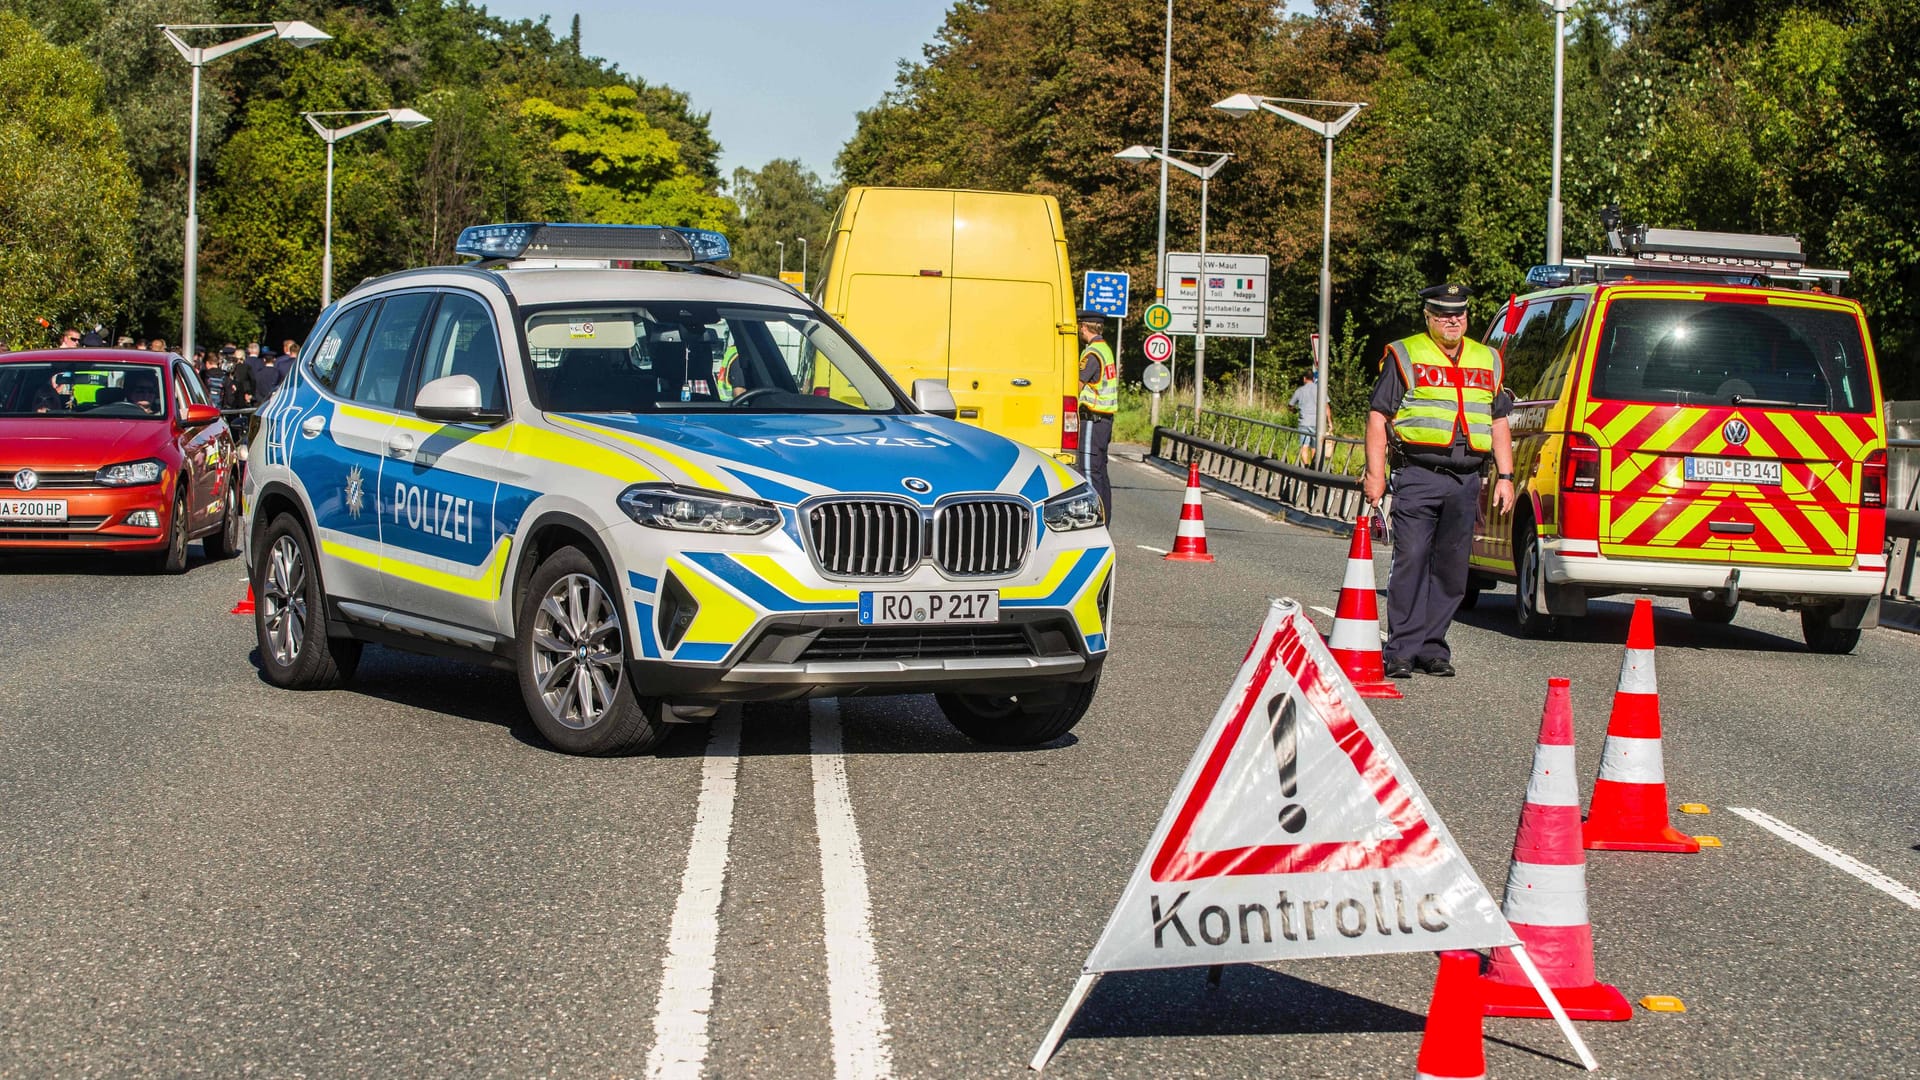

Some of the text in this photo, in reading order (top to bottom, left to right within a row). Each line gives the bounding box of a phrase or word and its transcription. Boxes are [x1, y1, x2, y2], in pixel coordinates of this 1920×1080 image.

[1182, 304, 1251, 313] wwwauttabelle.de
[1153, 310, 1164, 325] H
[1151, 342, 1166, 354] 70
[1414, 363, 1494, 391] POLIZEI
[740, 436, 952, 448] POLIZEI
[1696, 460, 1723, 476] BGD
[1734, 462, 1751, 477] FB
[1754, 463, 1779, 479] 141
[0, 502, 62, 516] A 200 HP
[394, 481, 473, 544] POLIZEI
[863, 594, 990, 620] D RO P 217
[1150, 880, 1449, 948] Kontrolle
